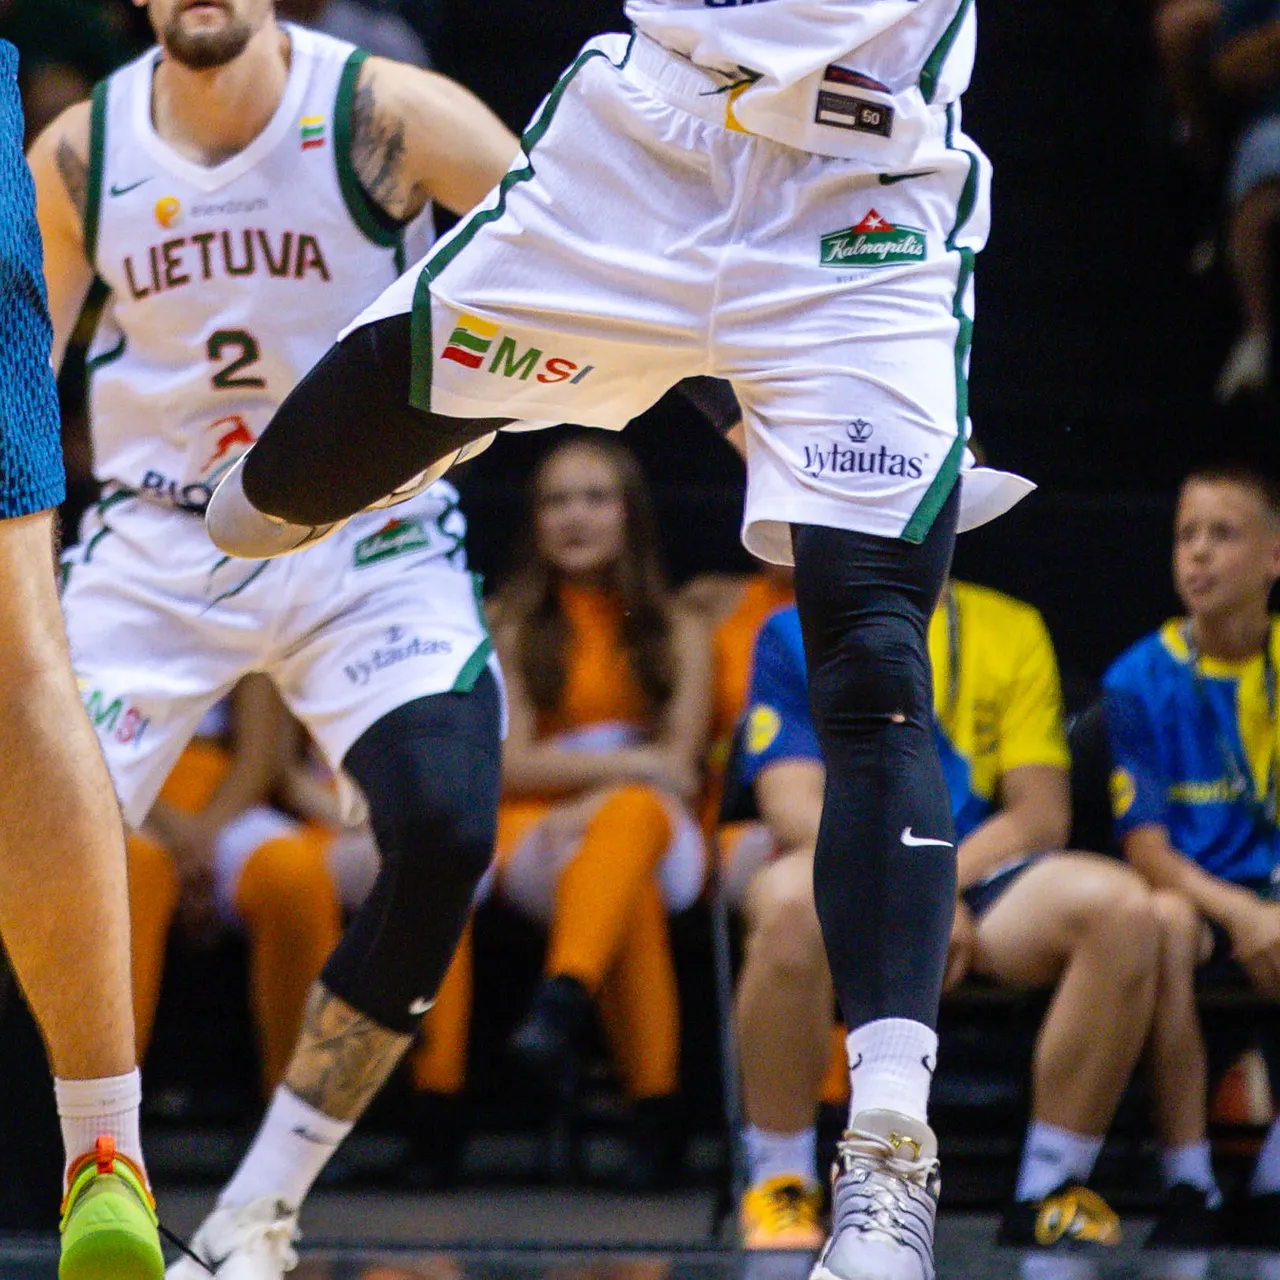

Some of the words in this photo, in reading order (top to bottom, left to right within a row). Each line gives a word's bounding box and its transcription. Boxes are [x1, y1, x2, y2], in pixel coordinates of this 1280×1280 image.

[123, 228, 331, 301] LIETUVA
[824, 234, 924, 261] Kalnapilis
[205, 328, 267, 390] 2
[488, 336, 595, 385] MSI
[804, 443, 924, 480] Vytautas
